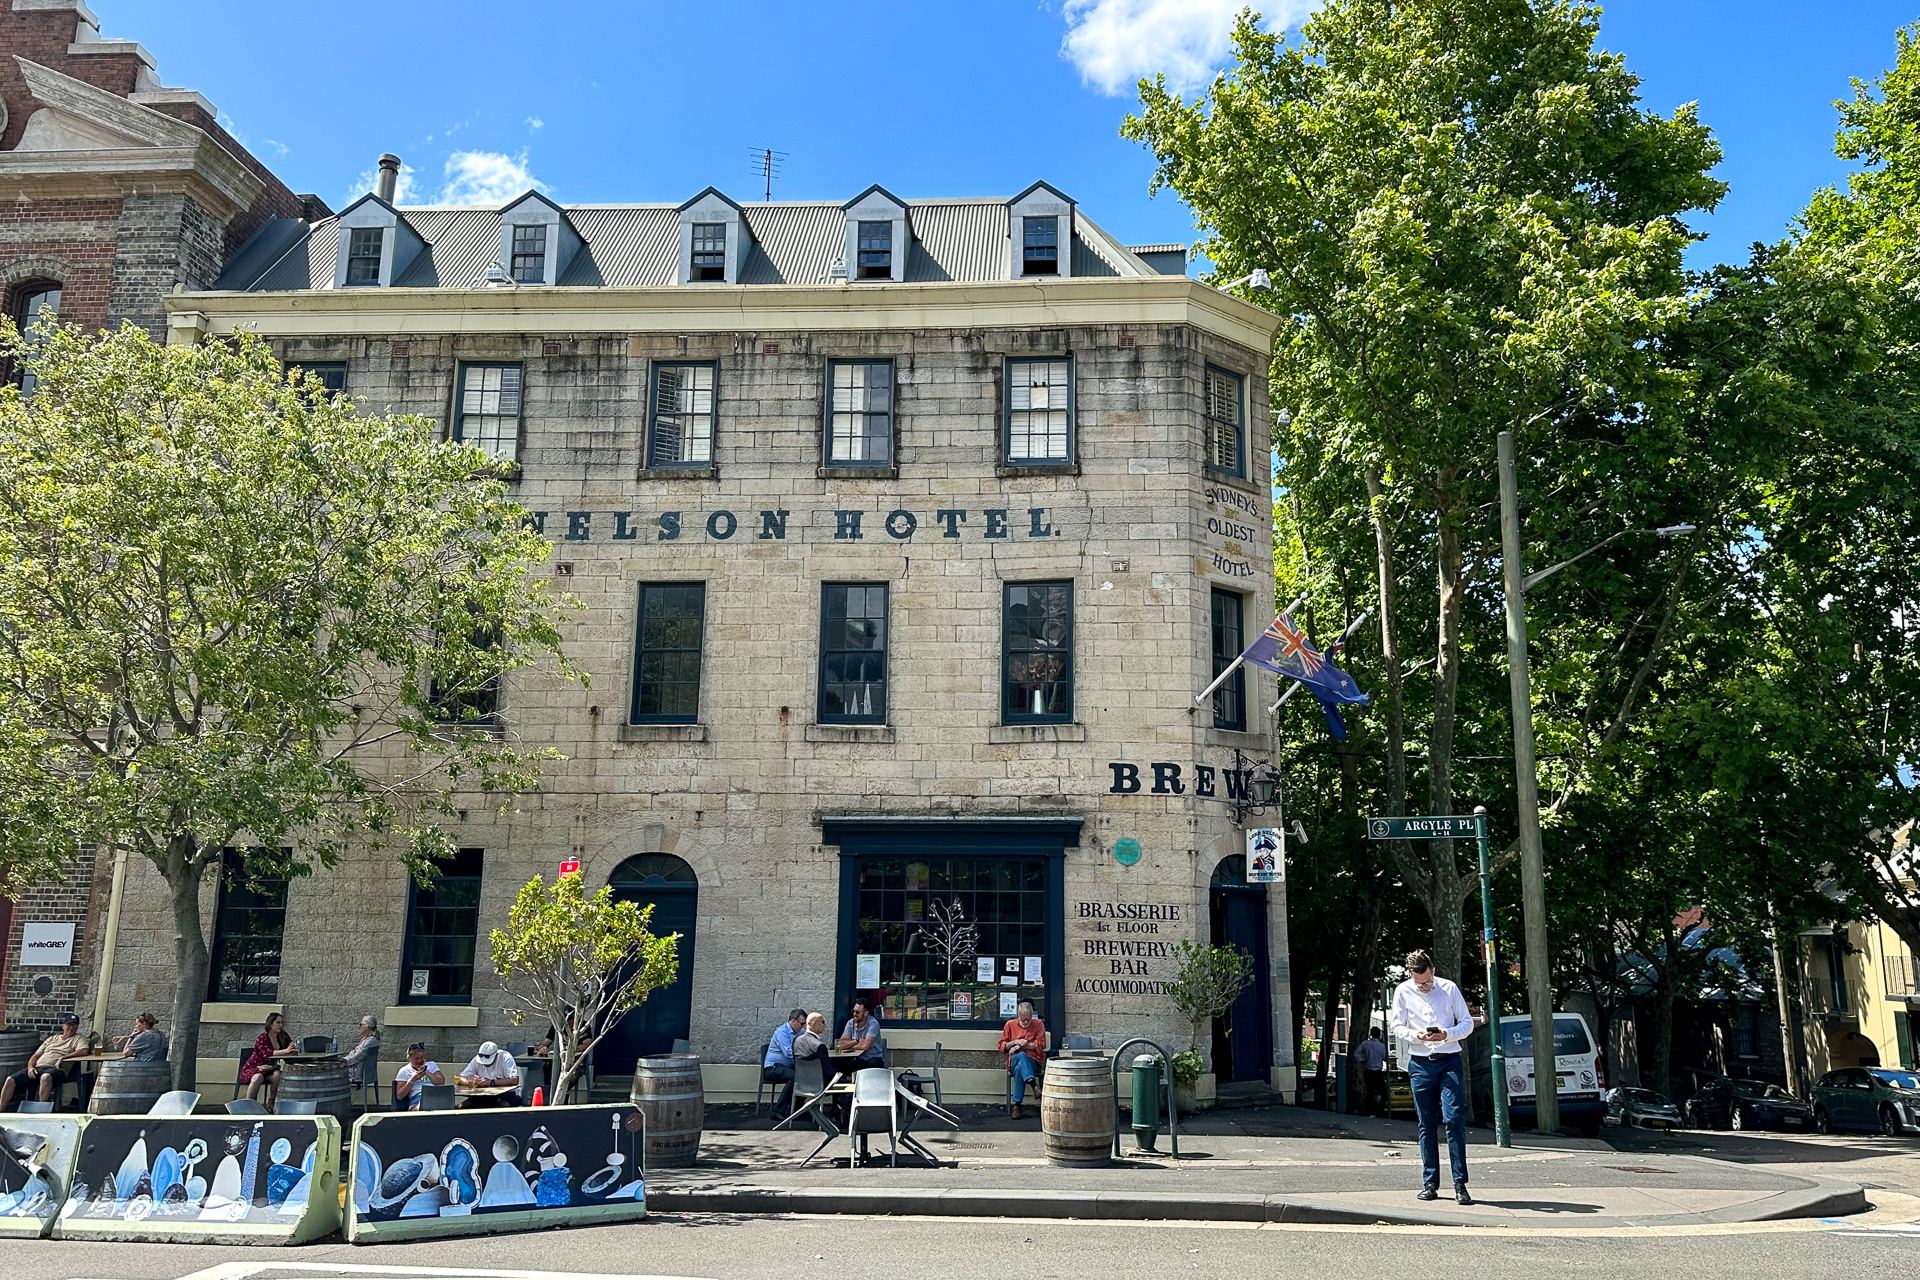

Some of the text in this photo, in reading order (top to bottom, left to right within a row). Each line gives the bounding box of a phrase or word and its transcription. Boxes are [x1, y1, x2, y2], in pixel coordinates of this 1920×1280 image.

[1205, 488, 1258, 517] SYDNEY'S
[520, 508, 790, 541] NELSON
[1208, 517, 1256, 543] OLDEST
[1212, 552, 1255, 577] HOTEL
[1405, 819, 1474, 830] ARGYLE PL
[1078, 902, 1180, 920] BRASSERIE
[1097, 921, 1159, 934] 1st FLOOR
[28, 940, 67, 948] whiteGREY
[1083, 940, 1170, 957] BREWERY
[1110, 959, 1149, 975] BAR
[1074, 978, 1182, 995] ACCOMMODATIO
